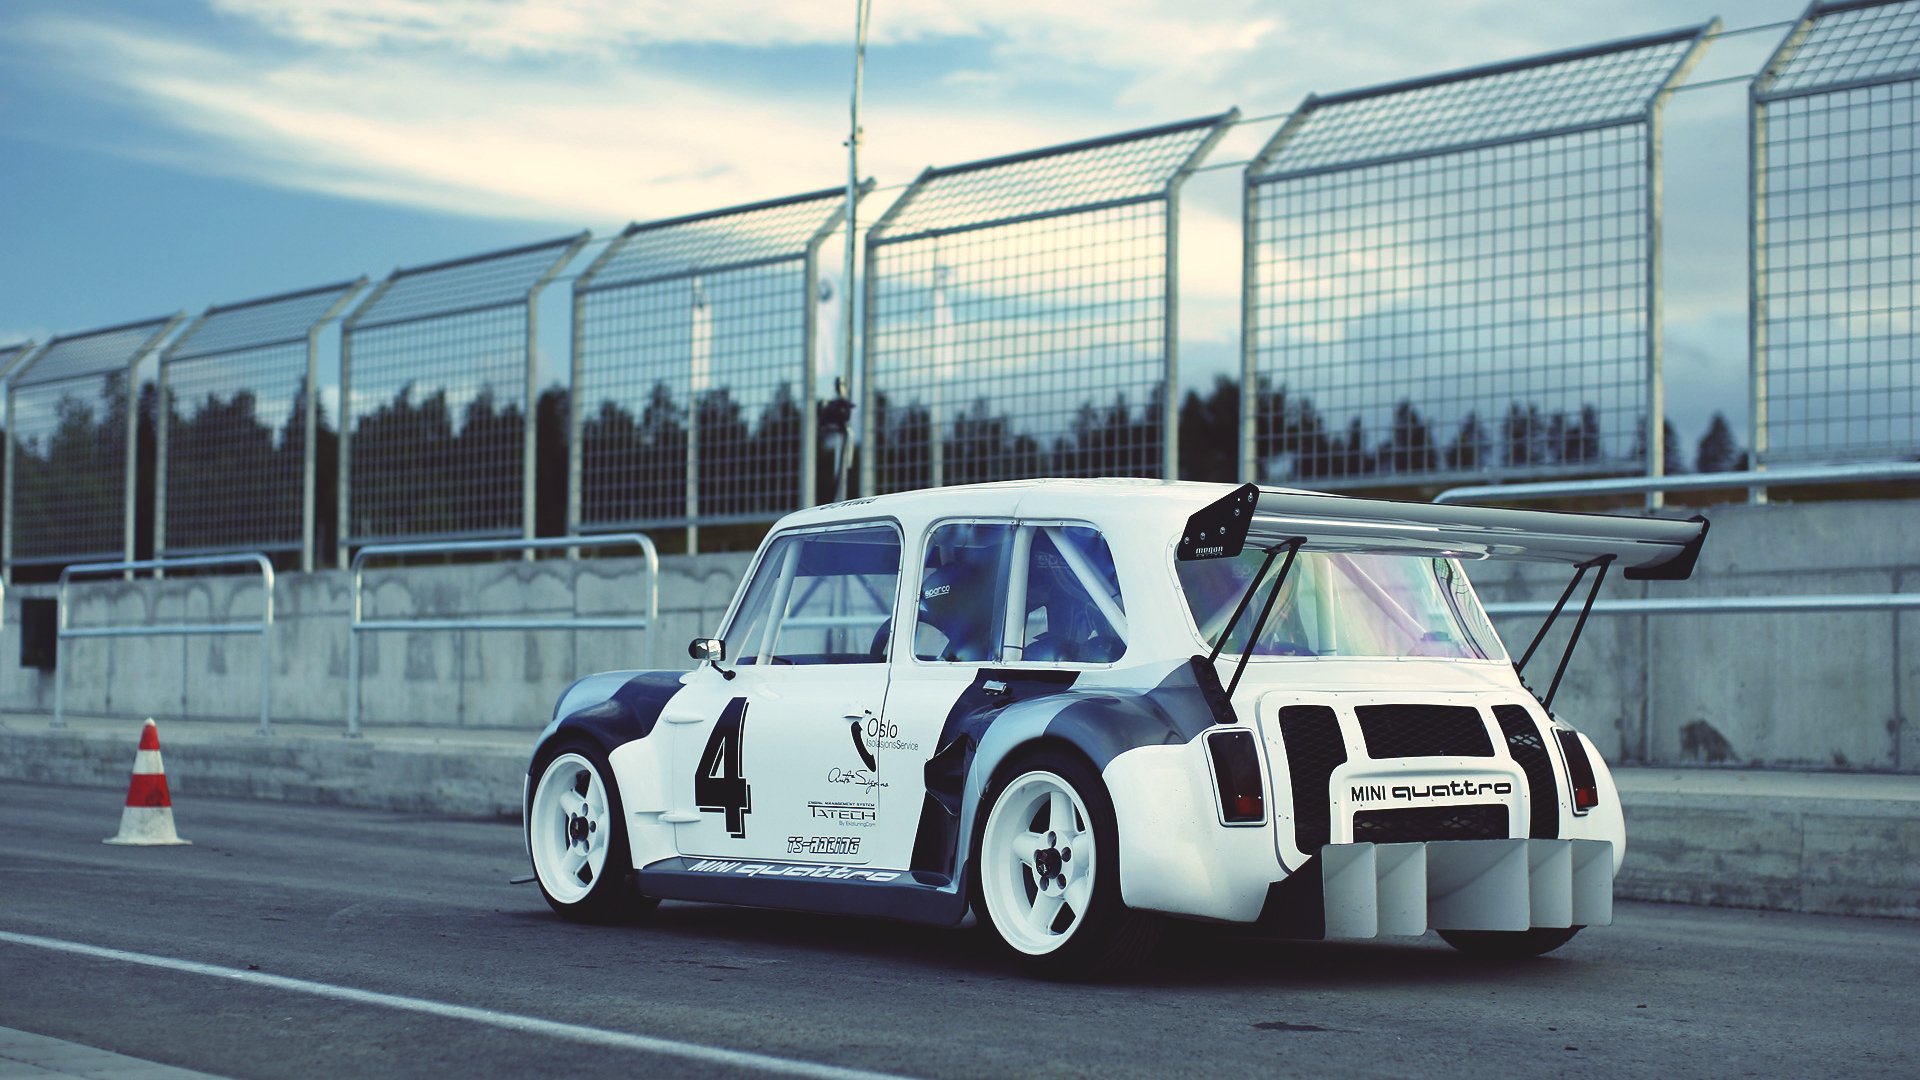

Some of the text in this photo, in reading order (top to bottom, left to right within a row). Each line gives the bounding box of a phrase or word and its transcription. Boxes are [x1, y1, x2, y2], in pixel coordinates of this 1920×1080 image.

[924, 584, 951, 598] sparco
[867, 717, 898, 739] Oslo
[695, 697, 752, 839] 4
[1351, 780, 1512, 802] MINI quattro
[807, 805, 876, 821] TATECH
[688, 859, 901, 882] MINI quattro
